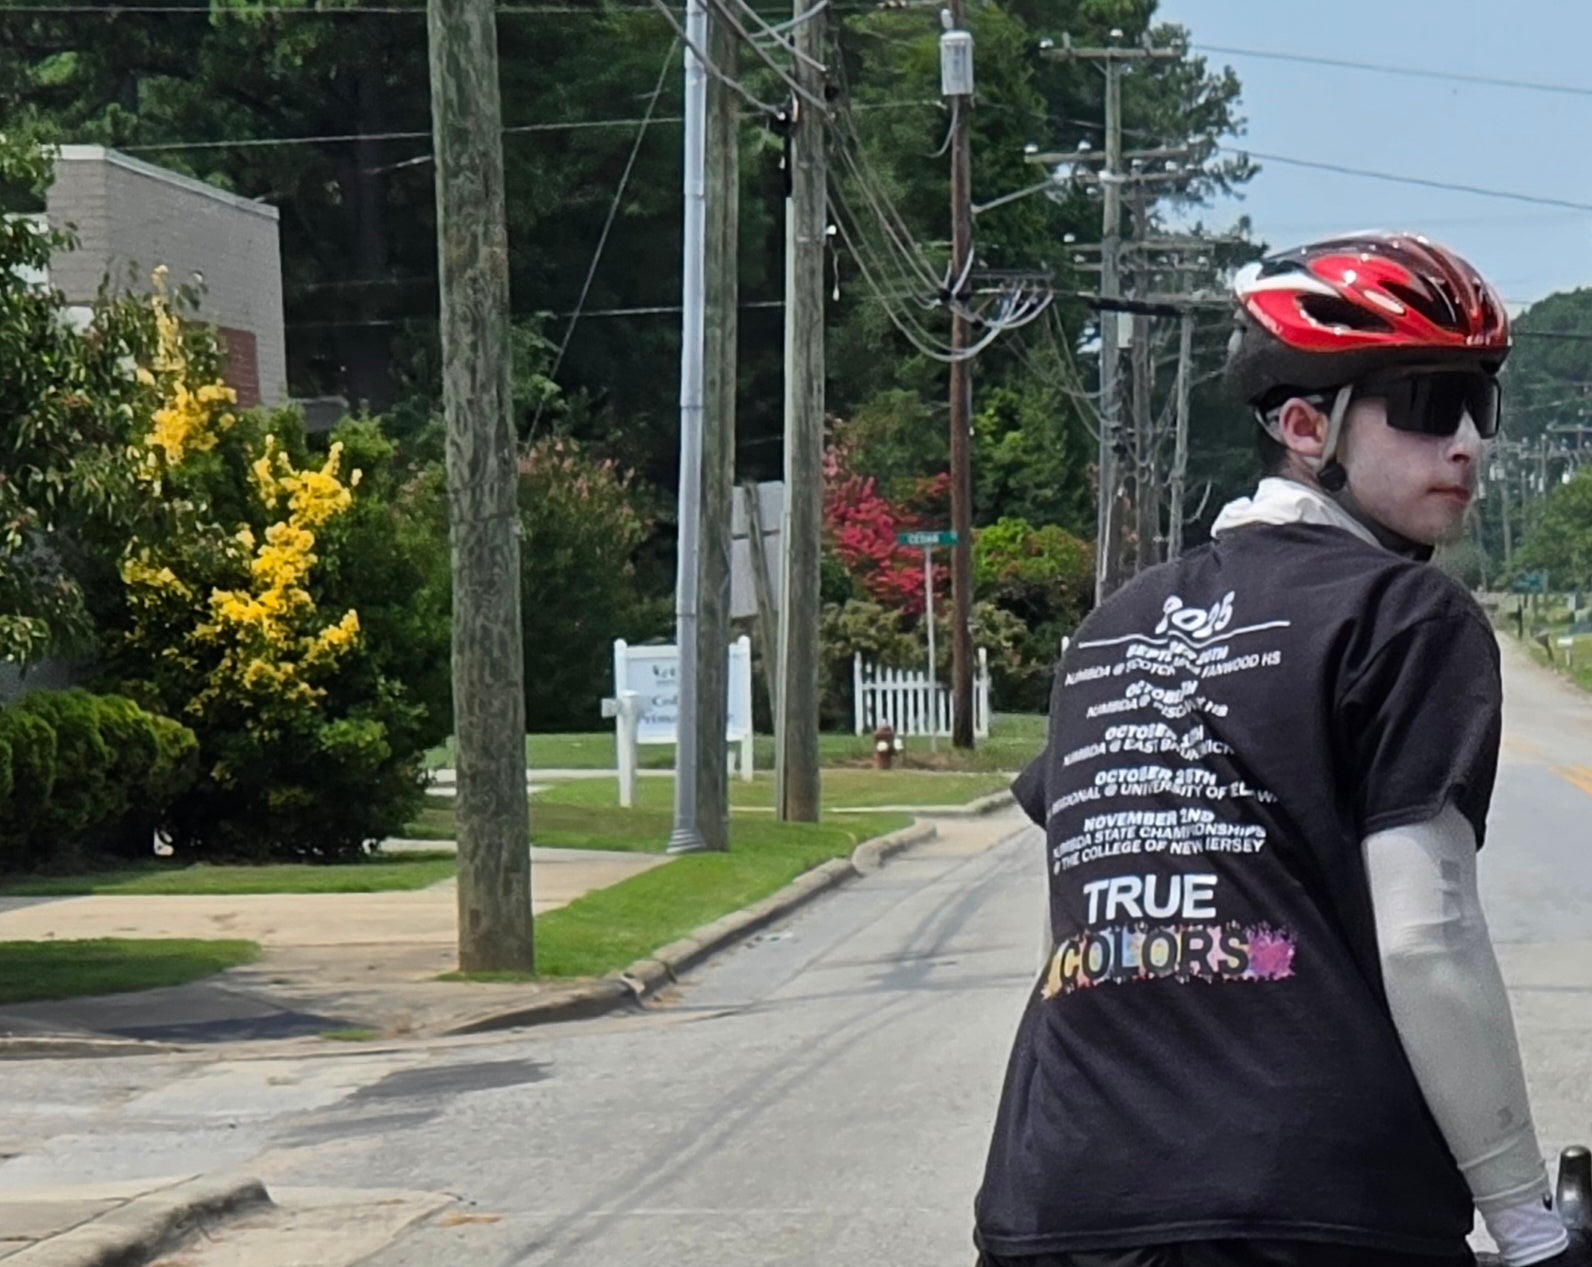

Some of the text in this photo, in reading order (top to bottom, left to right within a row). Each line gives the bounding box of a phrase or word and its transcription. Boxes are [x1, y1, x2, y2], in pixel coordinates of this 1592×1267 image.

[1261, 650, 1281, 667] HS
[1123, 738, 1159, 754] EAST
[1094, 765, 1173, 787] OCTOBER
[1103, 782, 1119, 797] @
[1205, 785, 1228, 801] OF
[1083, 808, 1216, 834] NOVEMBER 2ND
[1095, 826, 1137, 845] STATE
[1061, 852, 1080, 871] THE
[1081, 839, 1142, 863] COLLEGE
[1144, 838, 1169, 854] OF
[1170, 838, 1204, 856] NEW
[1083, 873, 1217, 924] TRUE
[1060, 929, 1249, 986] COLORS
